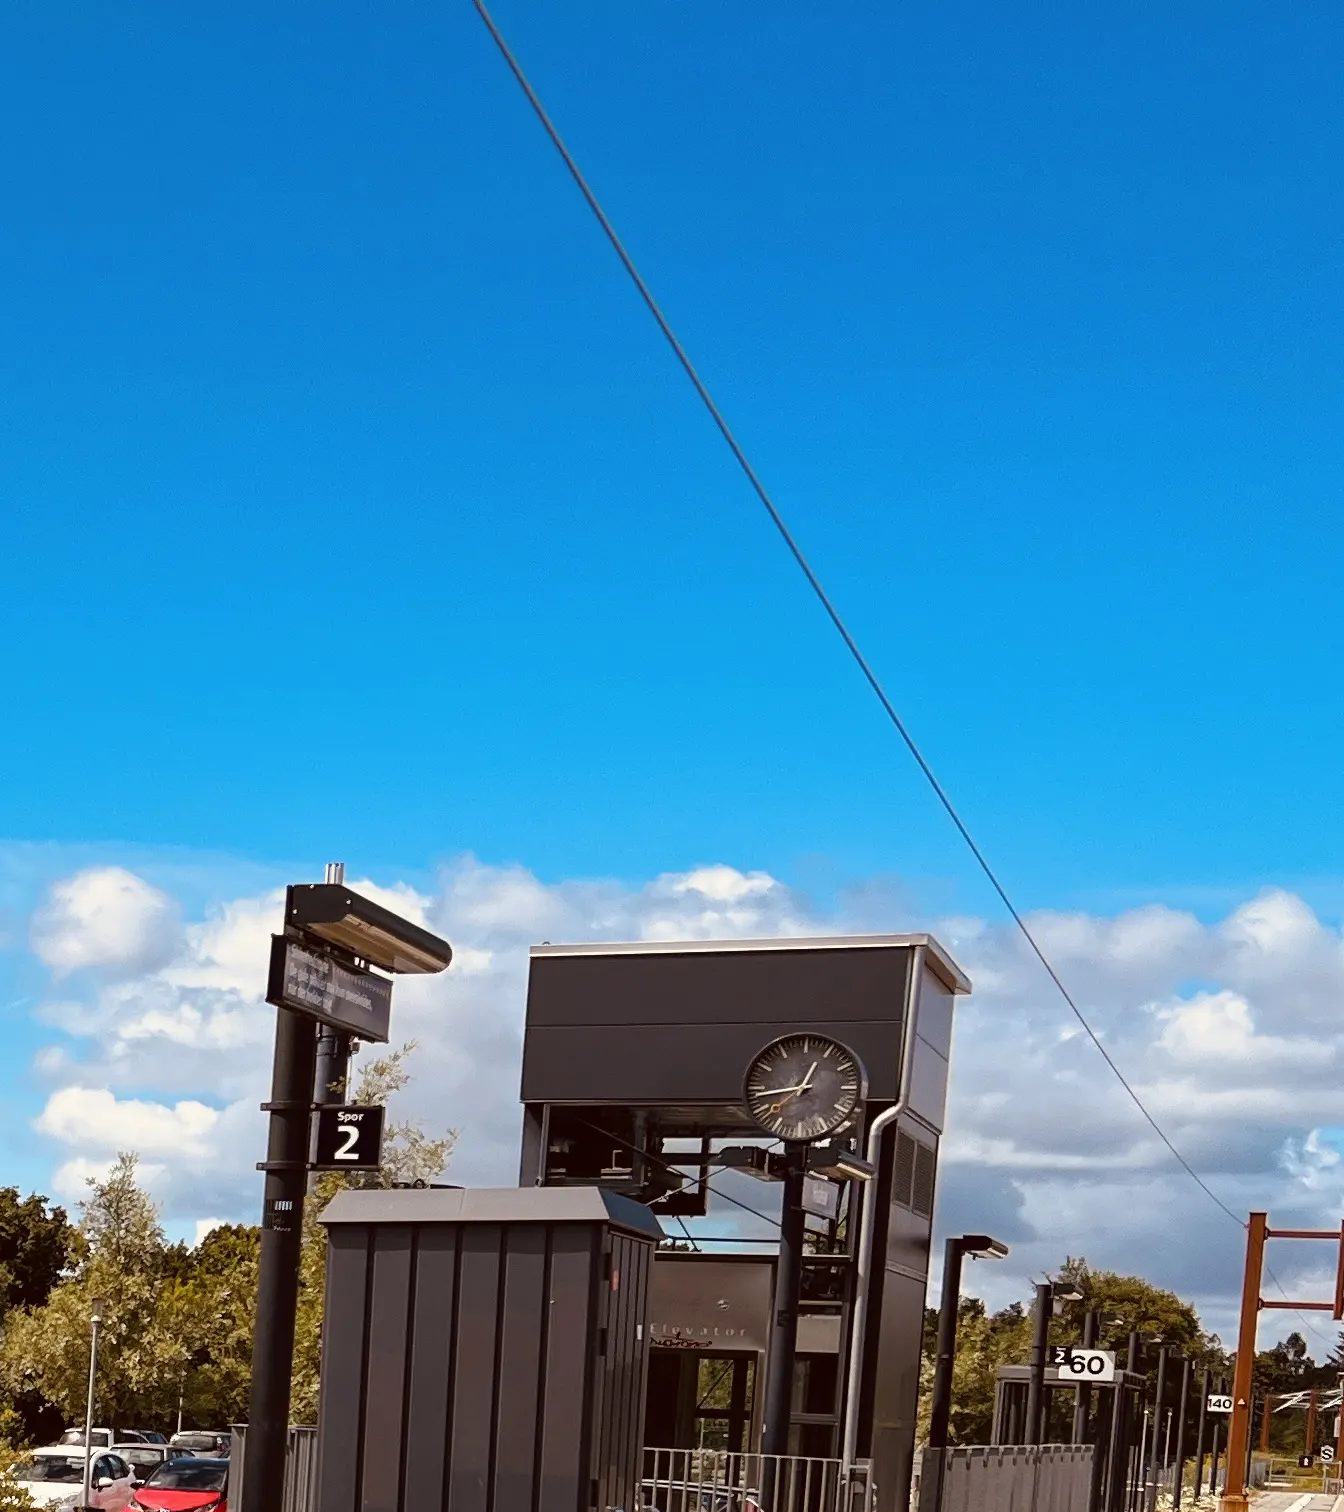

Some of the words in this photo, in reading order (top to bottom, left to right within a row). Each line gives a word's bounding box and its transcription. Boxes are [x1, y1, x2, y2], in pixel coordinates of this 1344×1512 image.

[337, 1111, 364, 1123] Spor
[334, 1125, 359, 1160] 2
[649, 1323, 746, 1336] Elevator
[1070, 1355, 1105, 1375] 60
[1321, 1448, 1332, 1461] S
